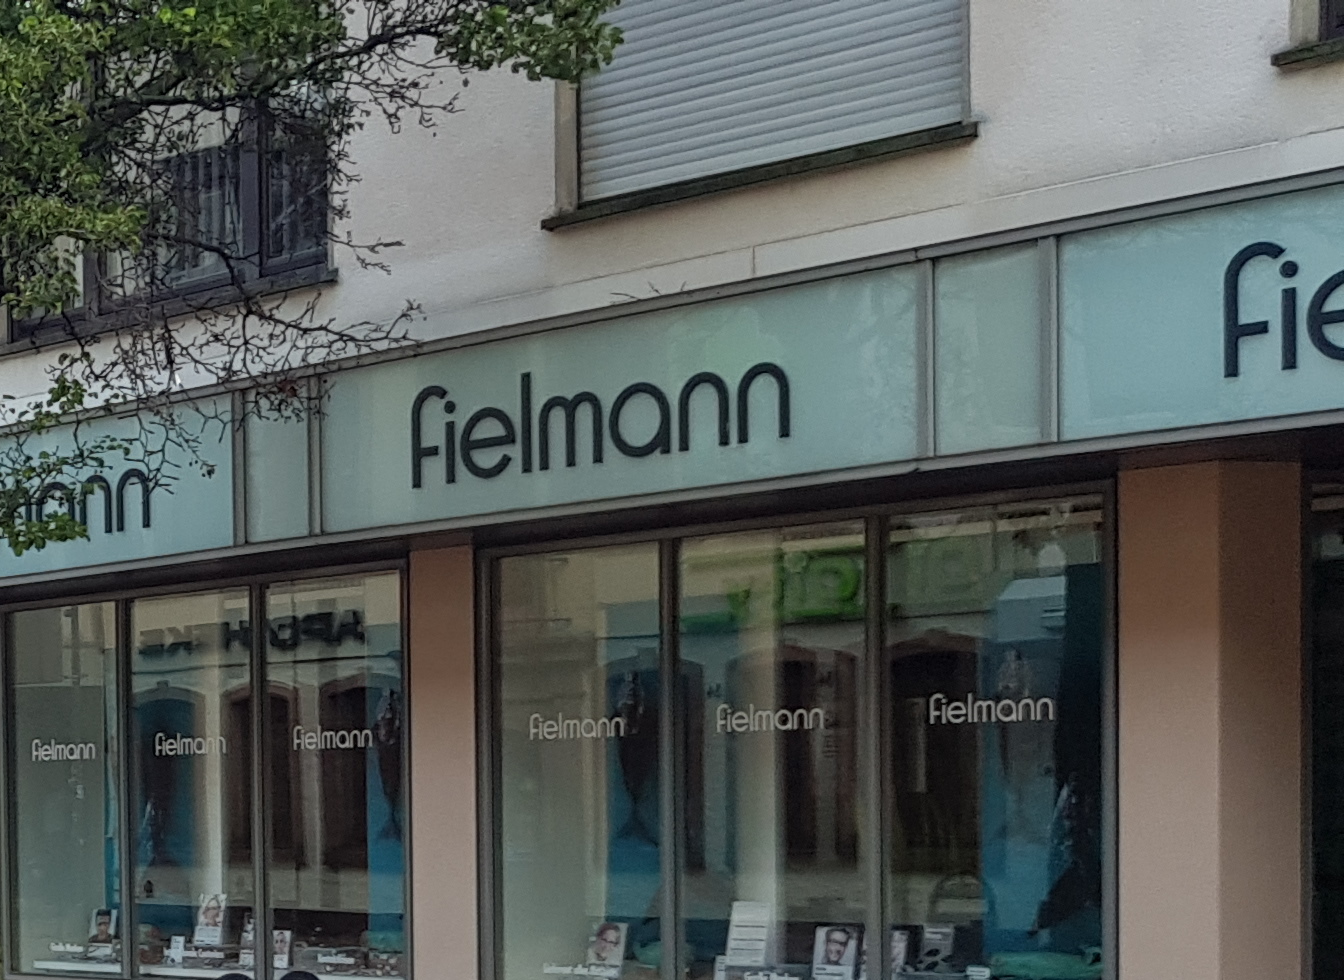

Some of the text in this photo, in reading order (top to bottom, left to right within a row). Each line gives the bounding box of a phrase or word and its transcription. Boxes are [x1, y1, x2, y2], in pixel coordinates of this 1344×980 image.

[412, 361, 791, 489] fielmann
[716, 703, 824, 733] fielmann
[929, 692, 1054, 724] fielmann
[293, 725, 373, 750] fielmann
[529, 713, 625, 740] fielmann
[31, 738, 95, 762] fielmann
[154, 732, 226, 756] fielmann
